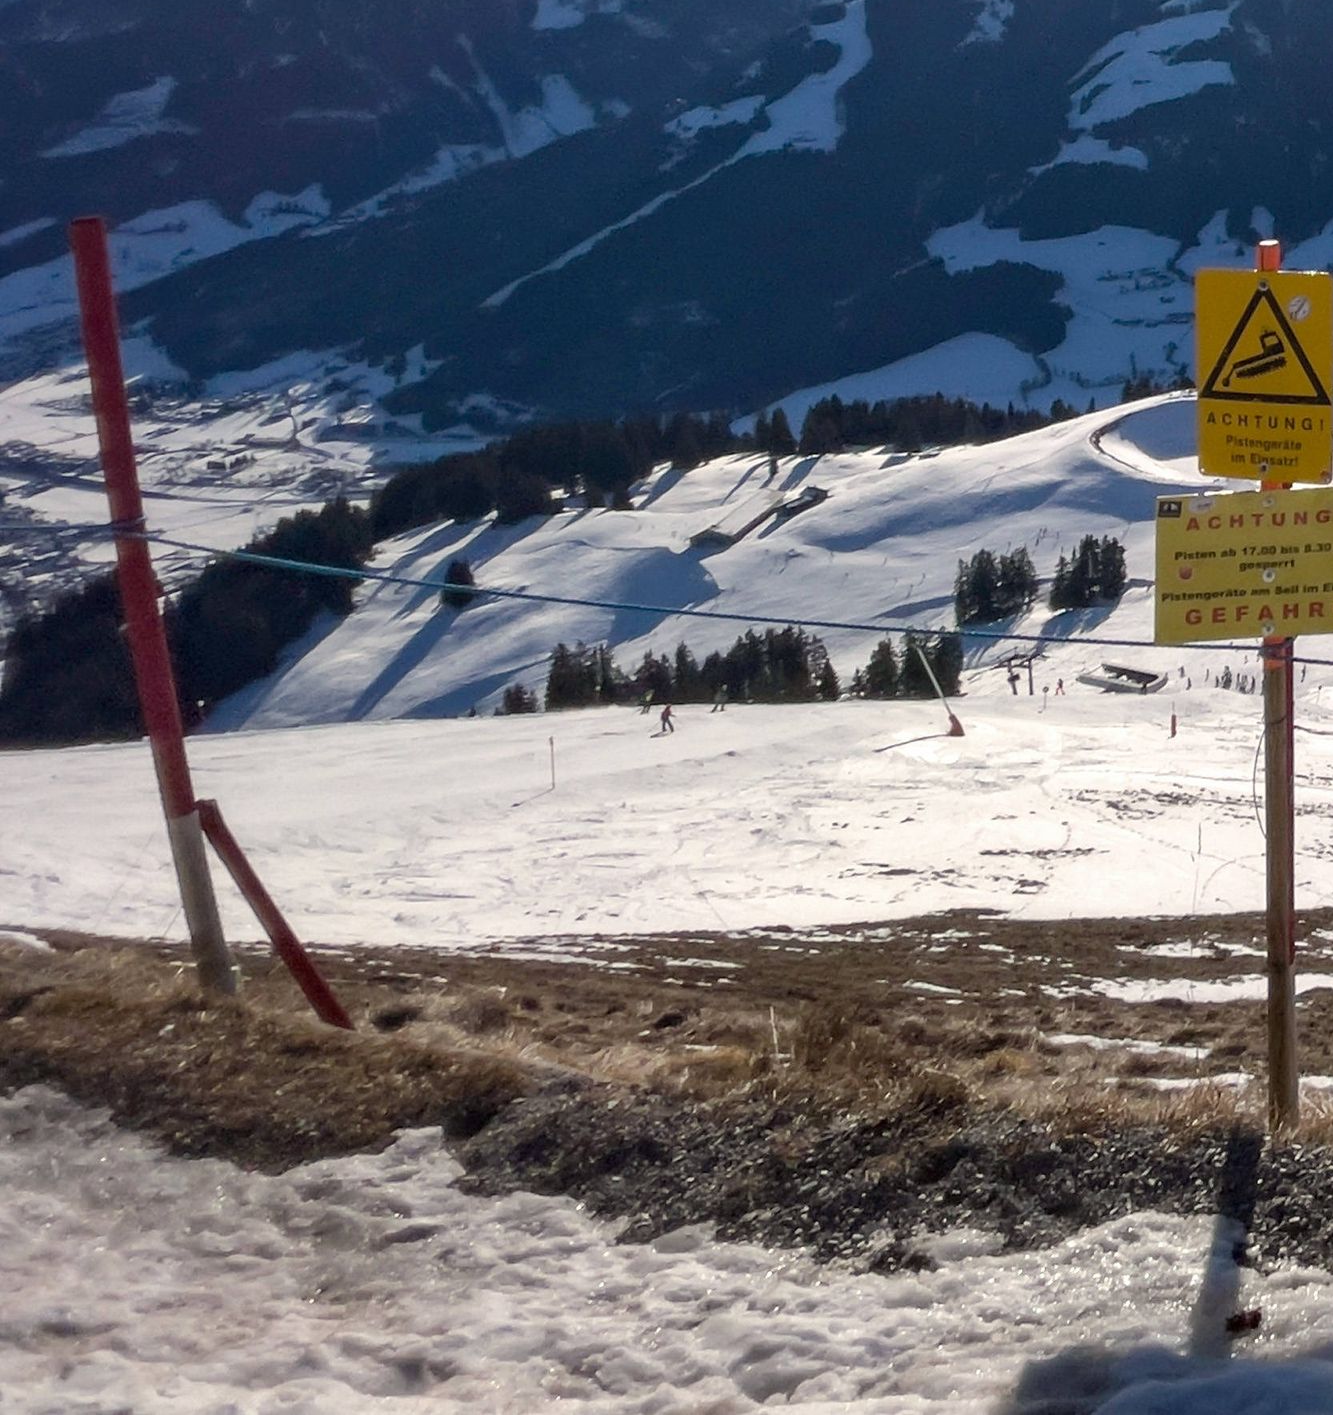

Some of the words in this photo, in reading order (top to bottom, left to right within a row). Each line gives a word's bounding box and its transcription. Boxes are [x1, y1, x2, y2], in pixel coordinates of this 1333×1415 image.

[1207, 412, 1324, 431] ACHTUNG!
[1226, 435, 1302, 451] Pistengeräte
[1231, 453, 1245, 463] im
[1250, 453, 1298, 466] Einsatz!
[1175, 551, 1216, 560] Pisten
[1221, 550, 1236, 558] ab
[1281, 545, 1299, 554] bis
[1239, 559, 1295, 572] gesperrt
[1161, 589, 1247, 602] Pistengeräte
[1251, 588, 1270, 596] am
[1303, 584, 1318, 593] im
